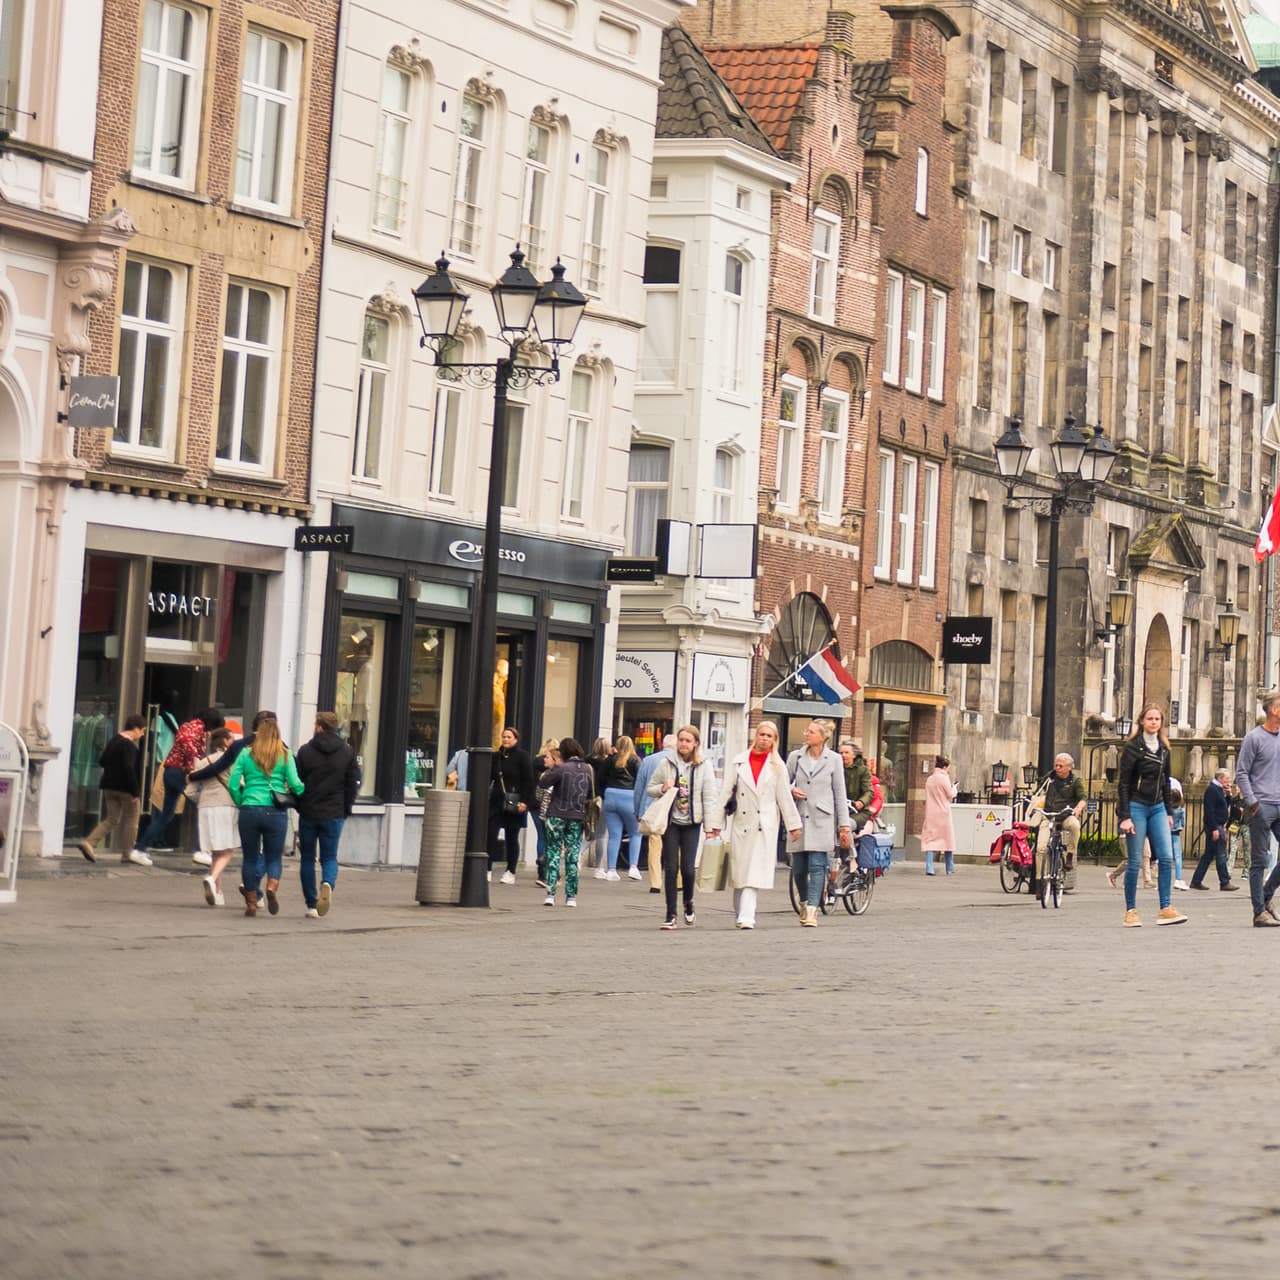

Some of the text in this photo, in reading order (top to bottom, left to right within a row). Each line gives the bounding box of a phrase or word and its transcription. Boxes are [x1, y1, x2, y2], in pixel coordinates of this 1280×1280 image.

[300, 533, 350, 544] ASPACT
[147, 591, 211, 617] ASPACT
[952, 633, 983, 646] shoeby
[641, 663, 660, 694] Service
